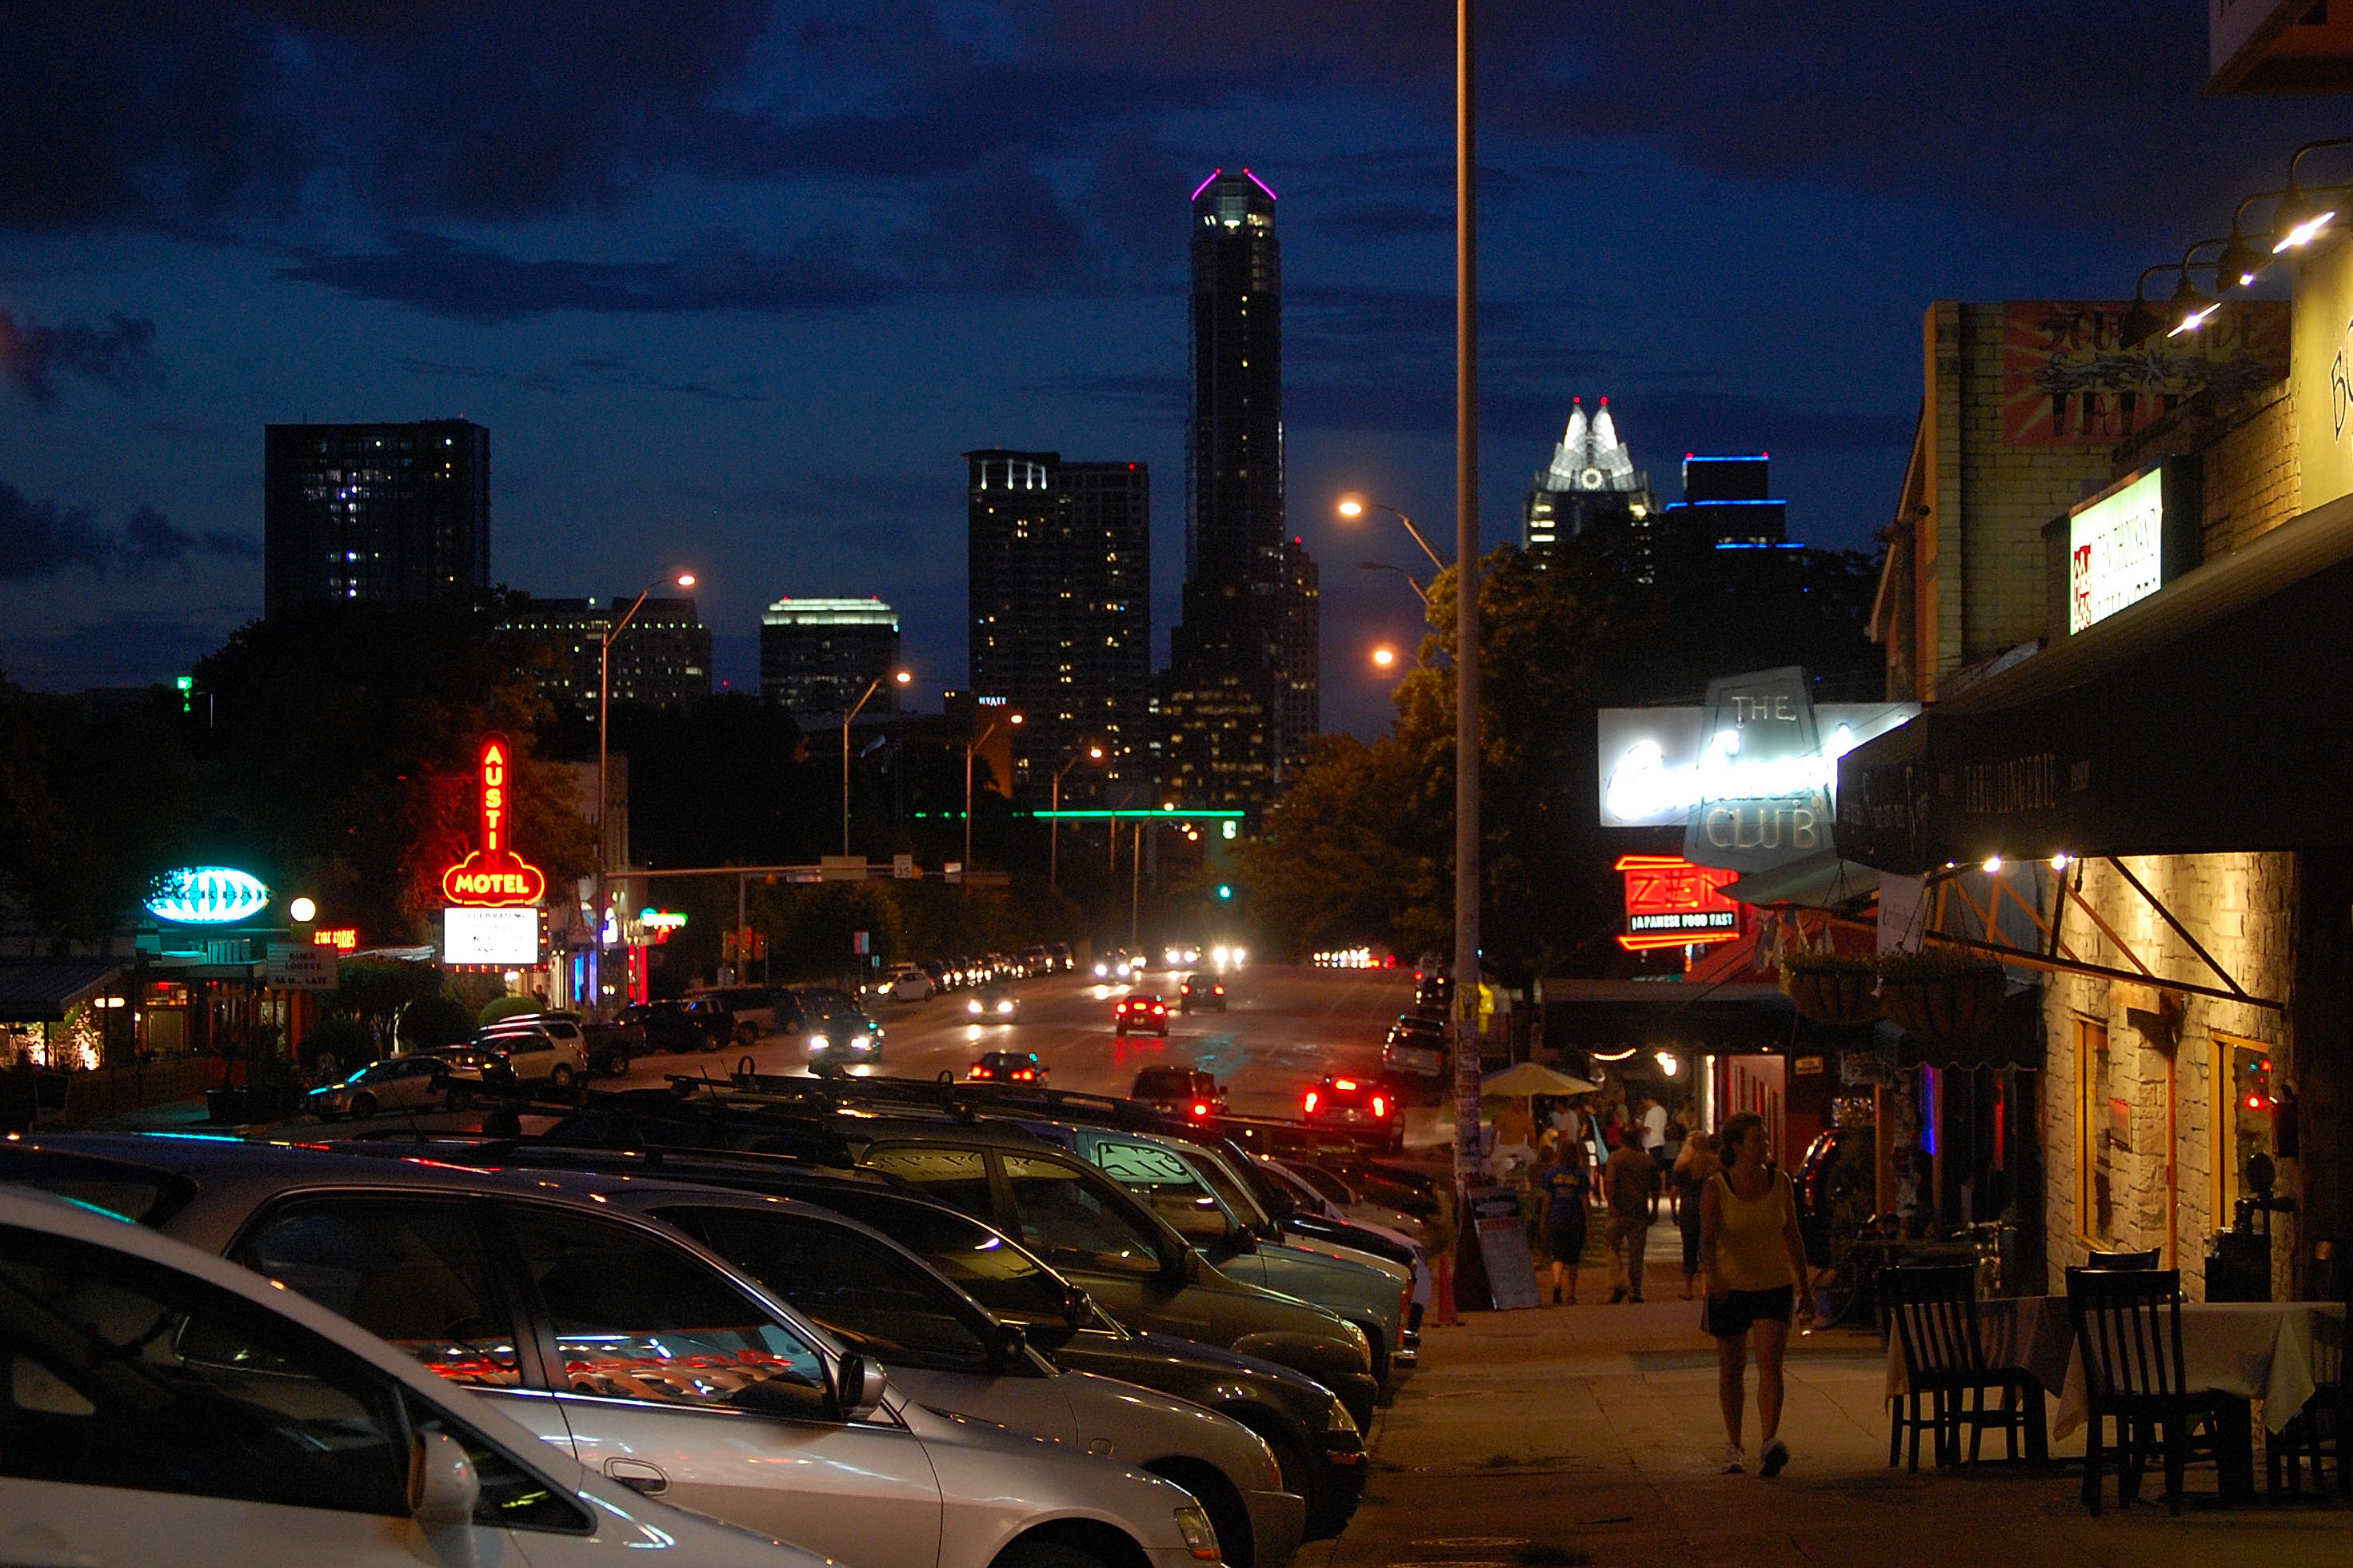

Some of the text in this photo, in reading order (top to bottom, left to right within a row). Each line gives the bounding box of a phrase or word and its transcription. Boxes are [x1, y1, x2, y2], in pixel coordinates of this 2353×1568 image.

[1732, 696, 1797, 722] THE
[485, 744, 503, 869] AUSTIN
[1706, 805, 1817, 849] CLUB
[454, 873, 530, 894] MOTEL
[1630, 870, 1734, 908] ZEN
[1632, 912, 1733, 931] JAPANESE FOOD FAST
